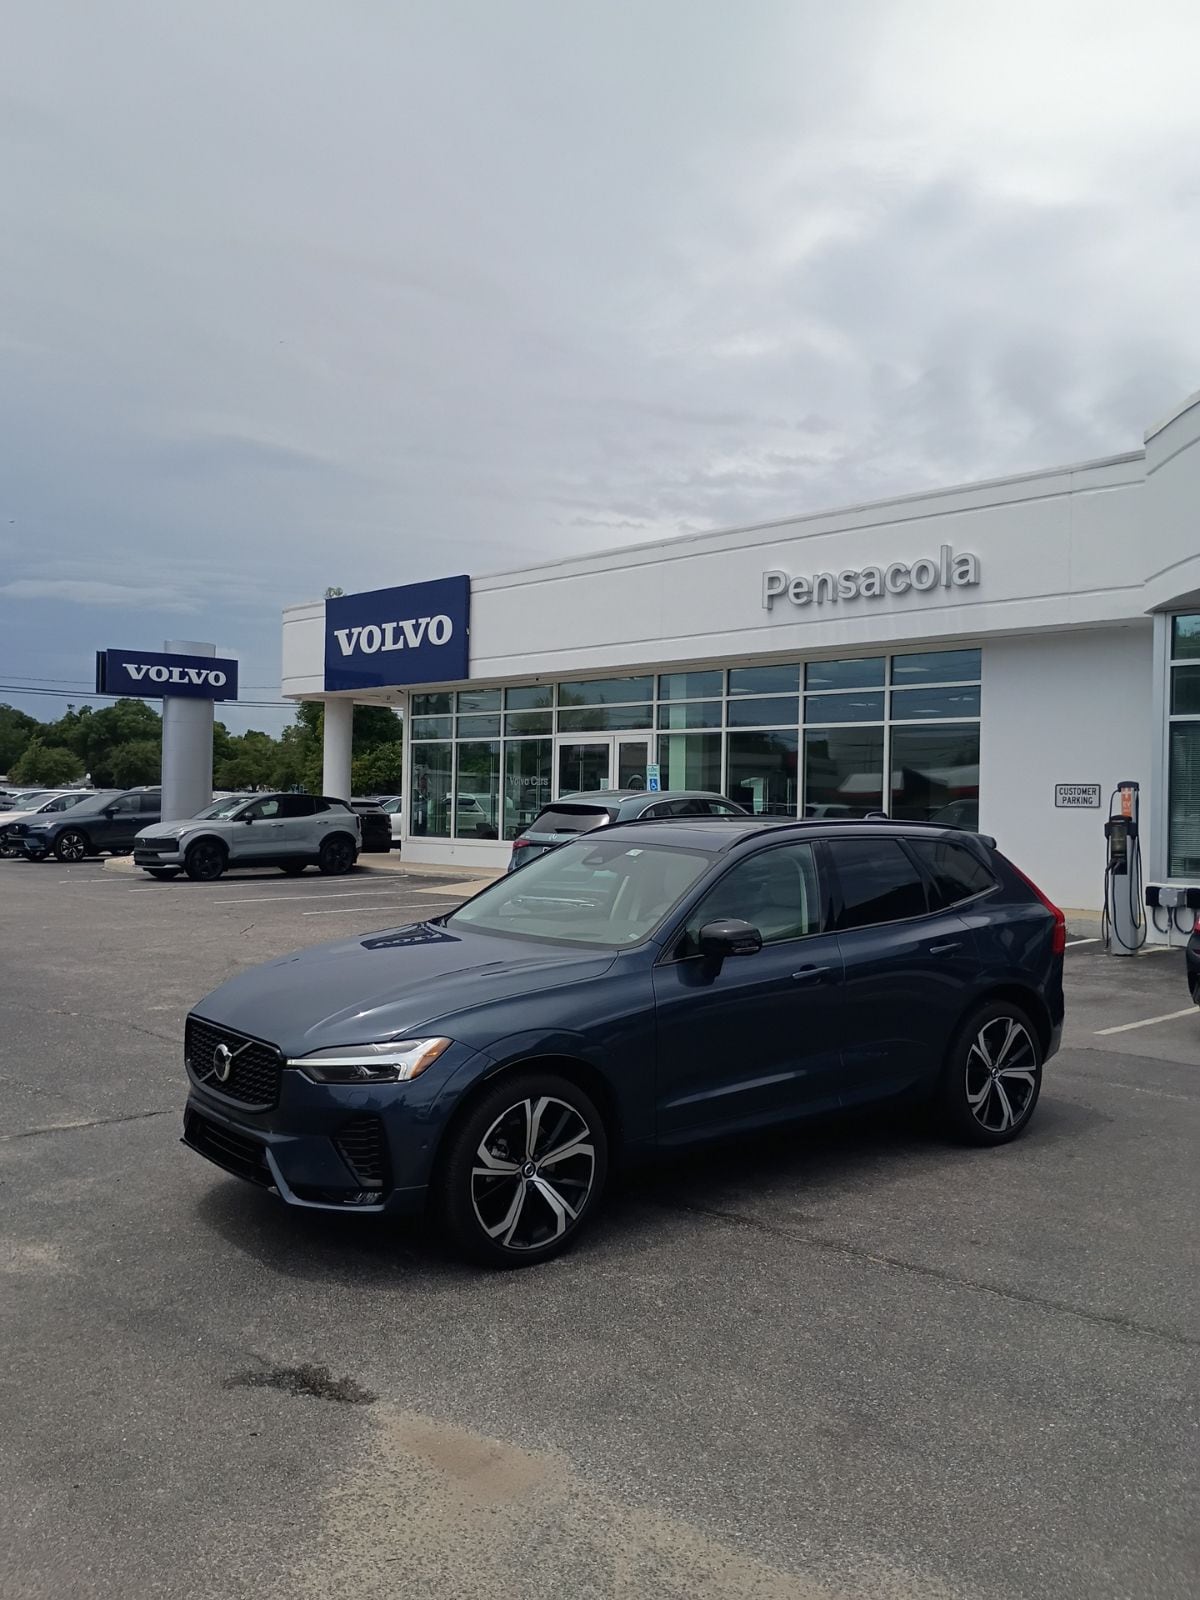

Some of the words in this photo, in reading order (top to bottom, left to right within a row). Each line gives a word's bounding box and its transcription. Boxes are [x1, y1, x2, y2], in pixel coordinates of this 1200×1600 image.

[762, 544, 980, 610] Pensacola
[334, 614, 453, 657] VOLVO
[122, 663, 227, 687] VOLVO
[1059, 787, 1097, 796] CUSTOMER
[1062, 796, 1093, 805] PARKING
